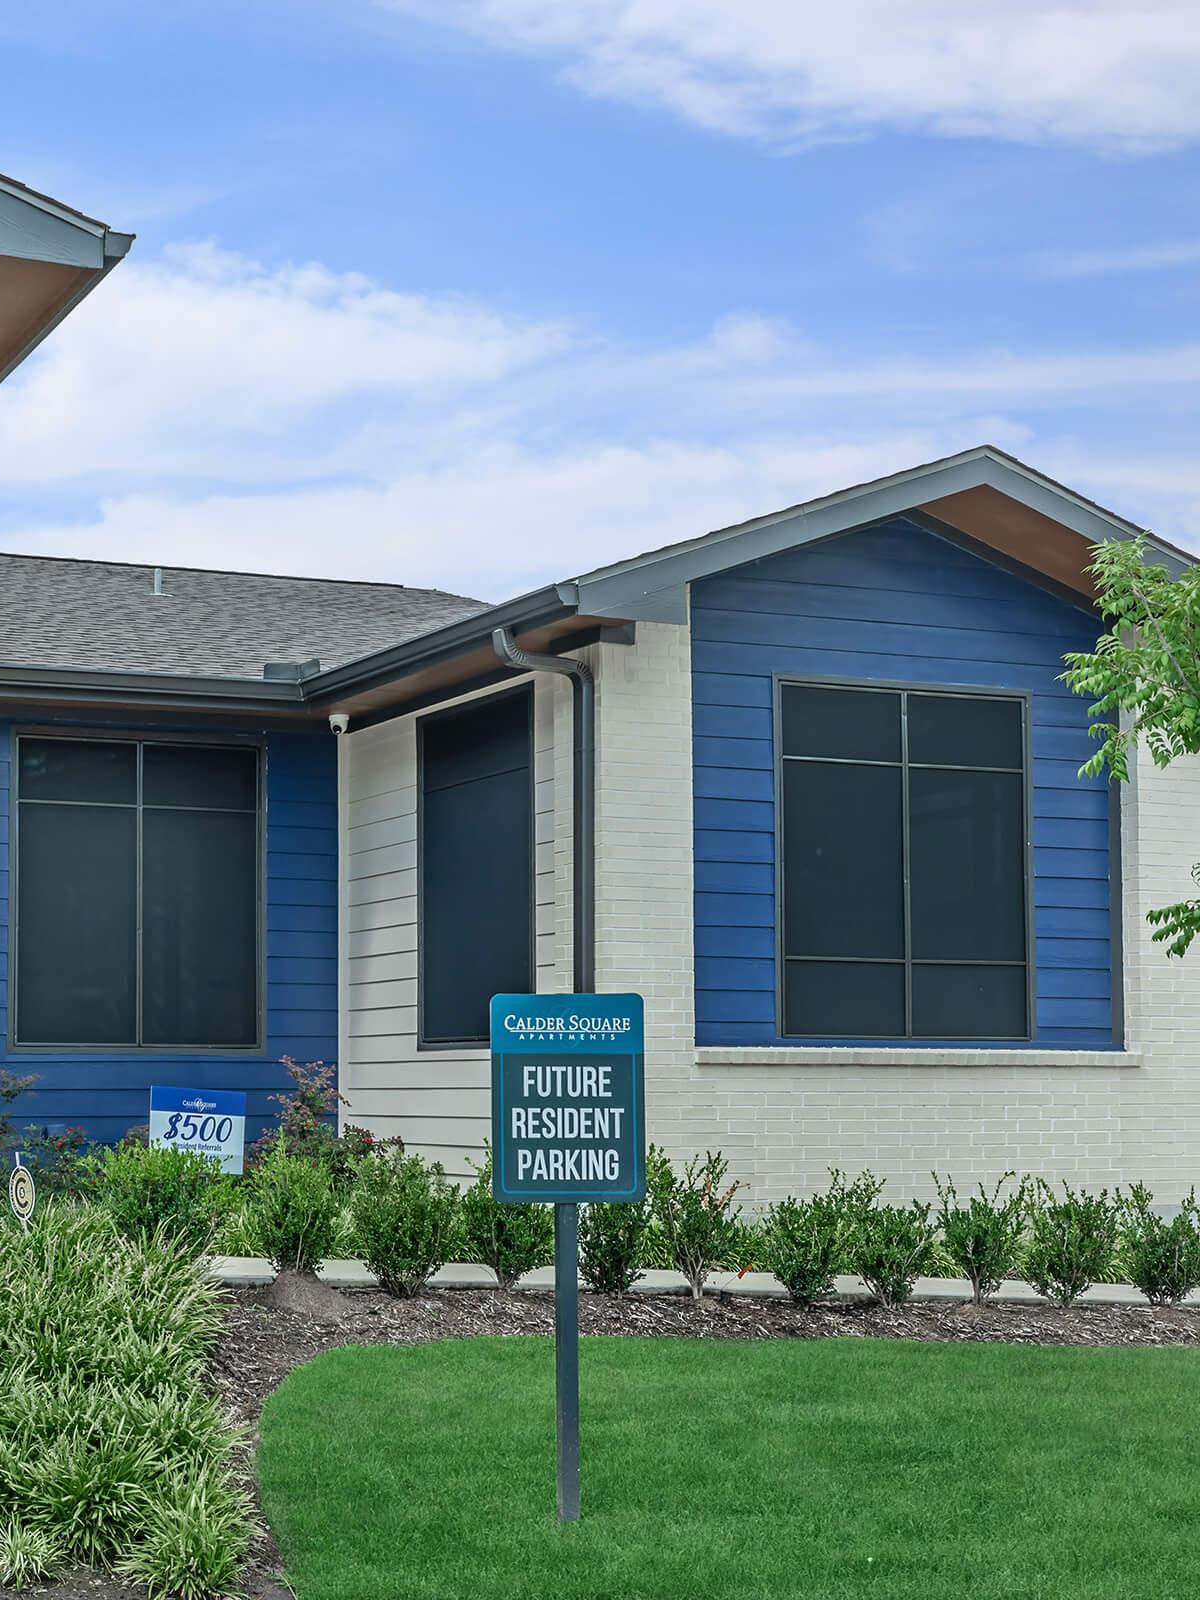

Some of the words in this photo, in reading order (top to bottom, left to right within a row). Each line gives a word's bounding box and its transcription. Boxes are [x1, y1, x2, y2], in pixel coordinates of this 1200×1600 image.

[504, 1014, 564, 1031] CALDER
[569, 1015, 631, 1033] SQUARE
[519, 1033, 616, 1041] APARTMENTS
[522, 1066, 612, 1097] FUTURE
[163, 1112, 233, 1143] $500
[511, 1107, 625, 1139] RESIDENT
[175, 1142, 198, 1150] esident
[198, 1143, 222, 1151] Referrals
[517, 1149, 620, 1181] PARKING
